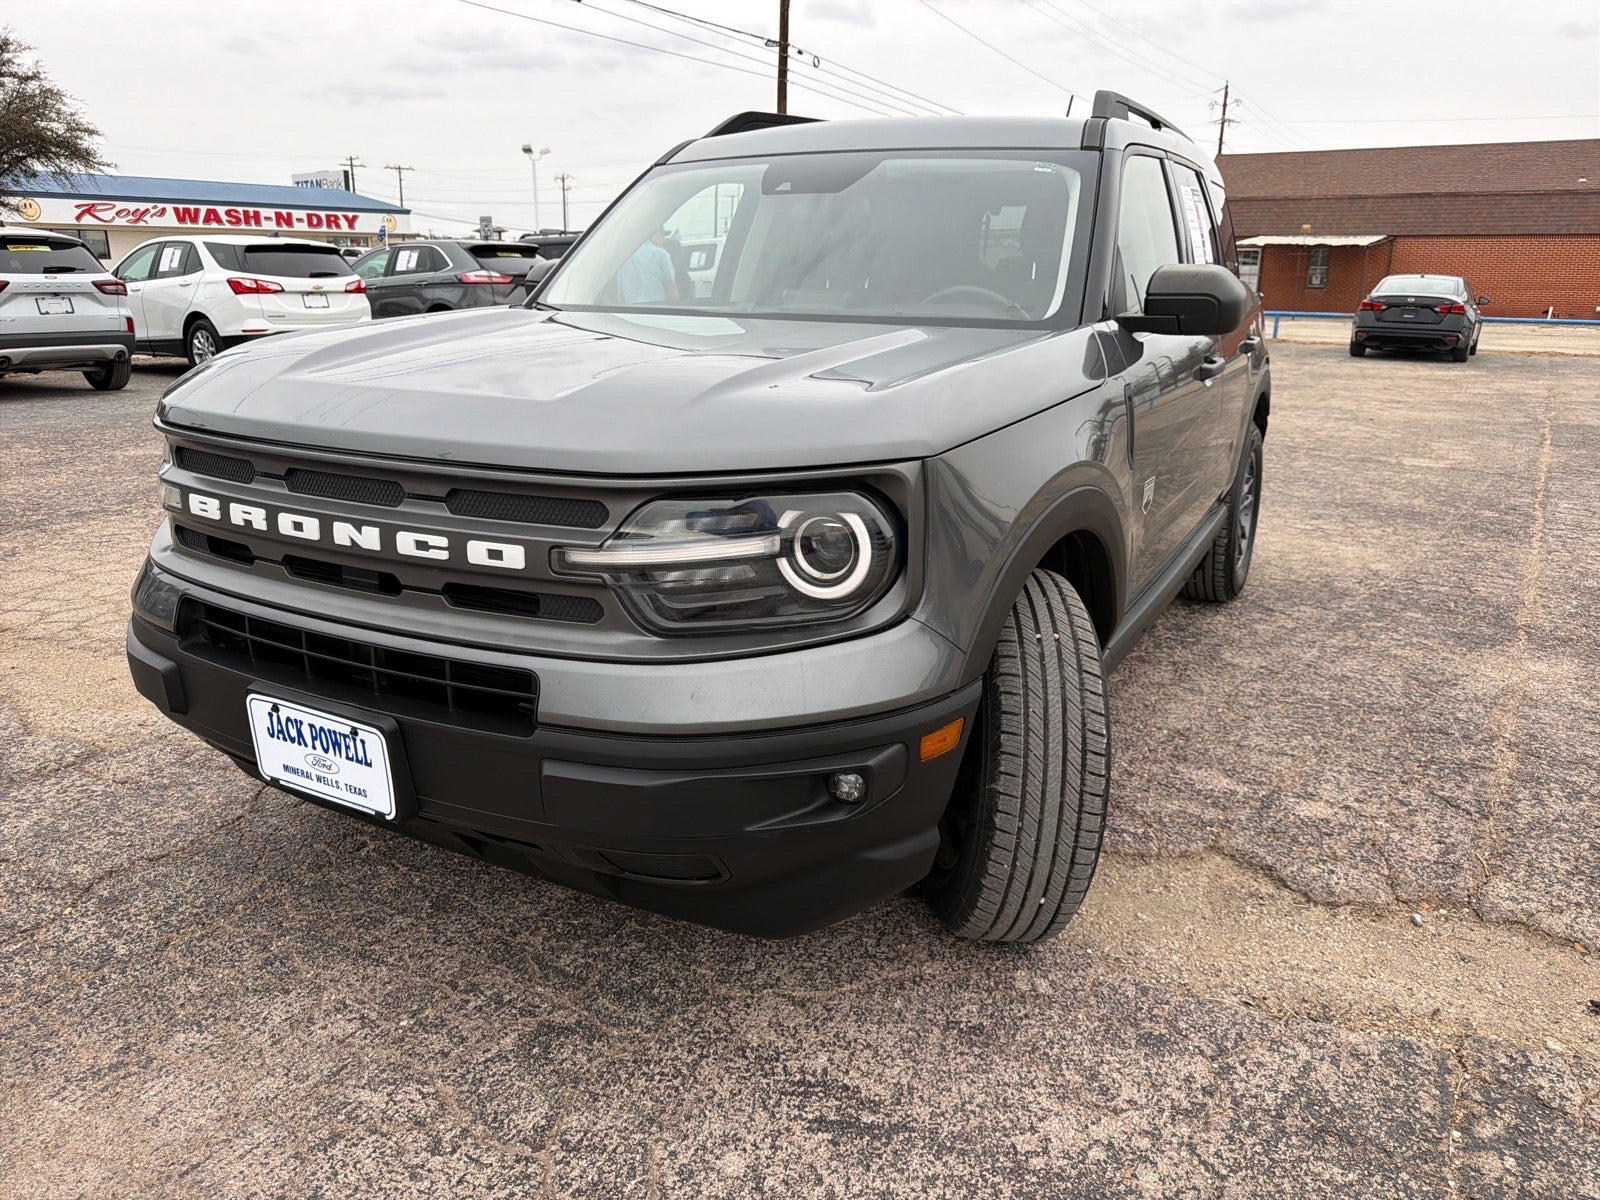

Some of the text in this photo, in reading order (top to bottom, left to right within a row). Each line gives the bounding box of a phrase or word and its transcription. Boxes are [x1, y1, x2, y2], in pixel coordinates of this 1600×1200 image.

[74, 202, 360, 231] Roy's WASH-N-DRY
[188, 493, 525, 570] BRONCO
[267, 711, 373, 769] JACK POWELL
[282, 763, 368, 799] MINERAL WELLS, TEXAS
[311, 755, 333, 771] Ford
